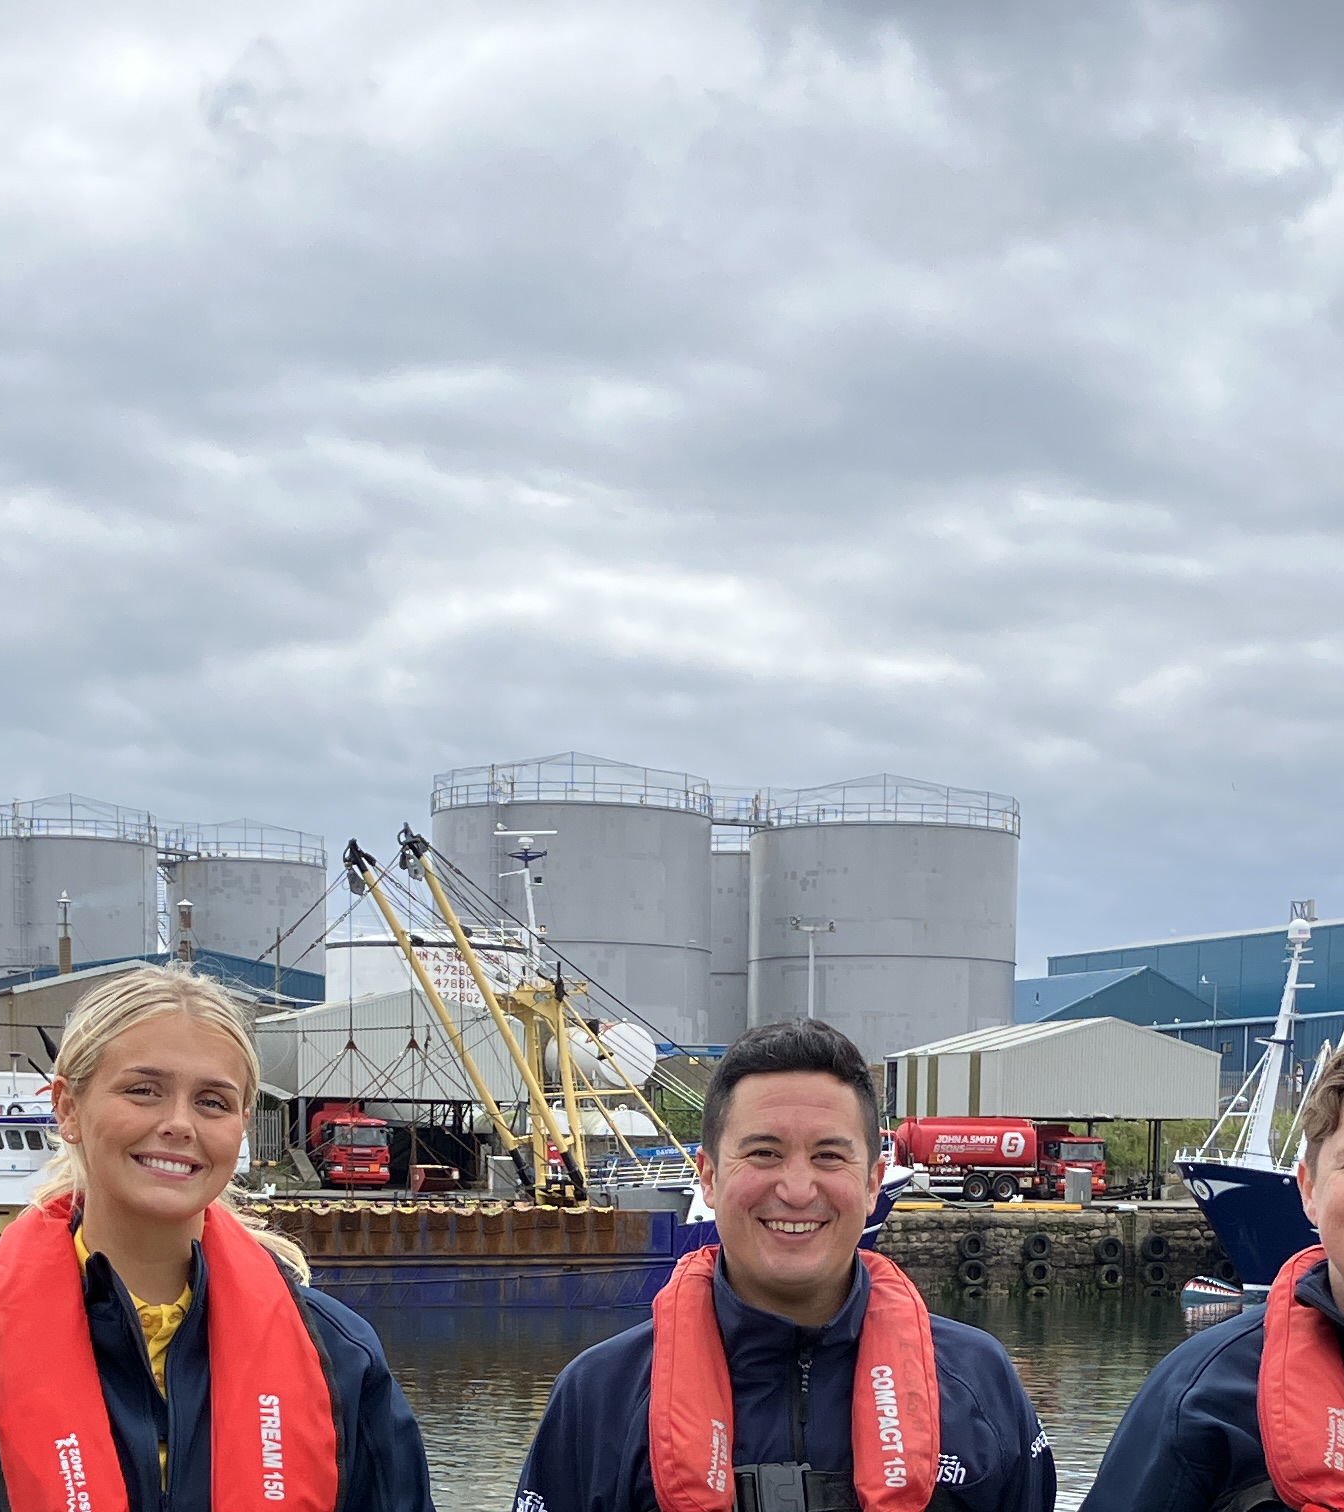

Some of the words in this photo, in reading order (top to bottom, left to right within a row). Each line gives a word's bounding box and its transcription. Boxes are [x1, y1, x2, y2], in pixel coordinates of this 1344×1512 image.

[434, 964, 472, 976] 47280
[936, 1135, 961, 1144] JOHN
[961, 1135, 969, 1144] A
[970, 1135, 998, 1144] SMITH
[870, 1365, 904, 1454] COMPACT
[258, 1394, 283, 1469] STREAM
[68, 1447, 87, 1488] 12402
[883, 1457, 907, 1488] 150
[1334, 1451, 1344, 1471] ISO
[263, 1471, 285, 1501] 150
[716, 1469, 727, 1493] ISO
